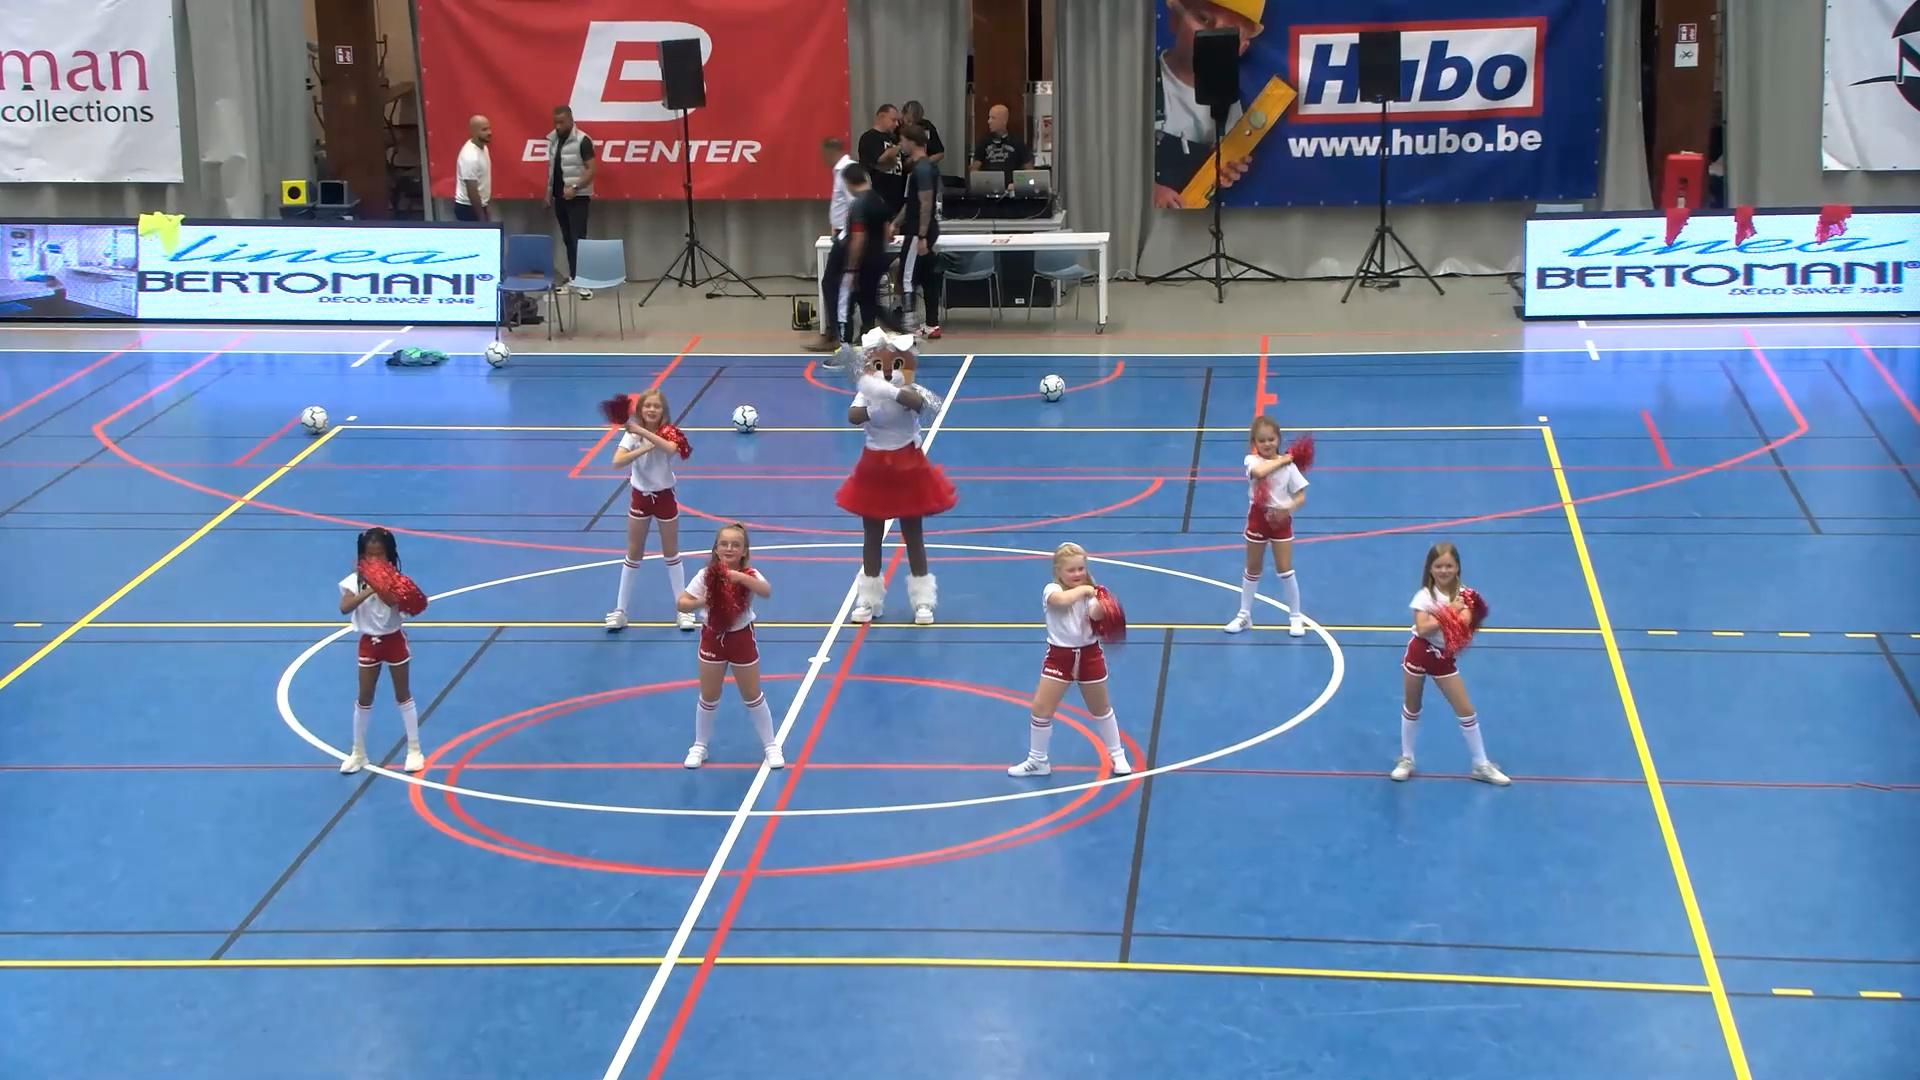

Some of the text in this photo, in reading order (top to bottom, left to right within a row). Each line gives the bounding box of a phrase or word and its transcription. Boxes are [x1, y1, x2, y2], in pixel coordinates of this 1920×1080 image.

[0, 50, 149, 92] man
[1, 99, 154, 122] collections
[1288, 124, 1542, 157] www.hubo.be
[319, 296, 372, 304] DECO
[375, 296, 431, 304] SINCE
[1728, 287, 1787, 296] DECO
[1792, 287, 1854, 295] SINCE
